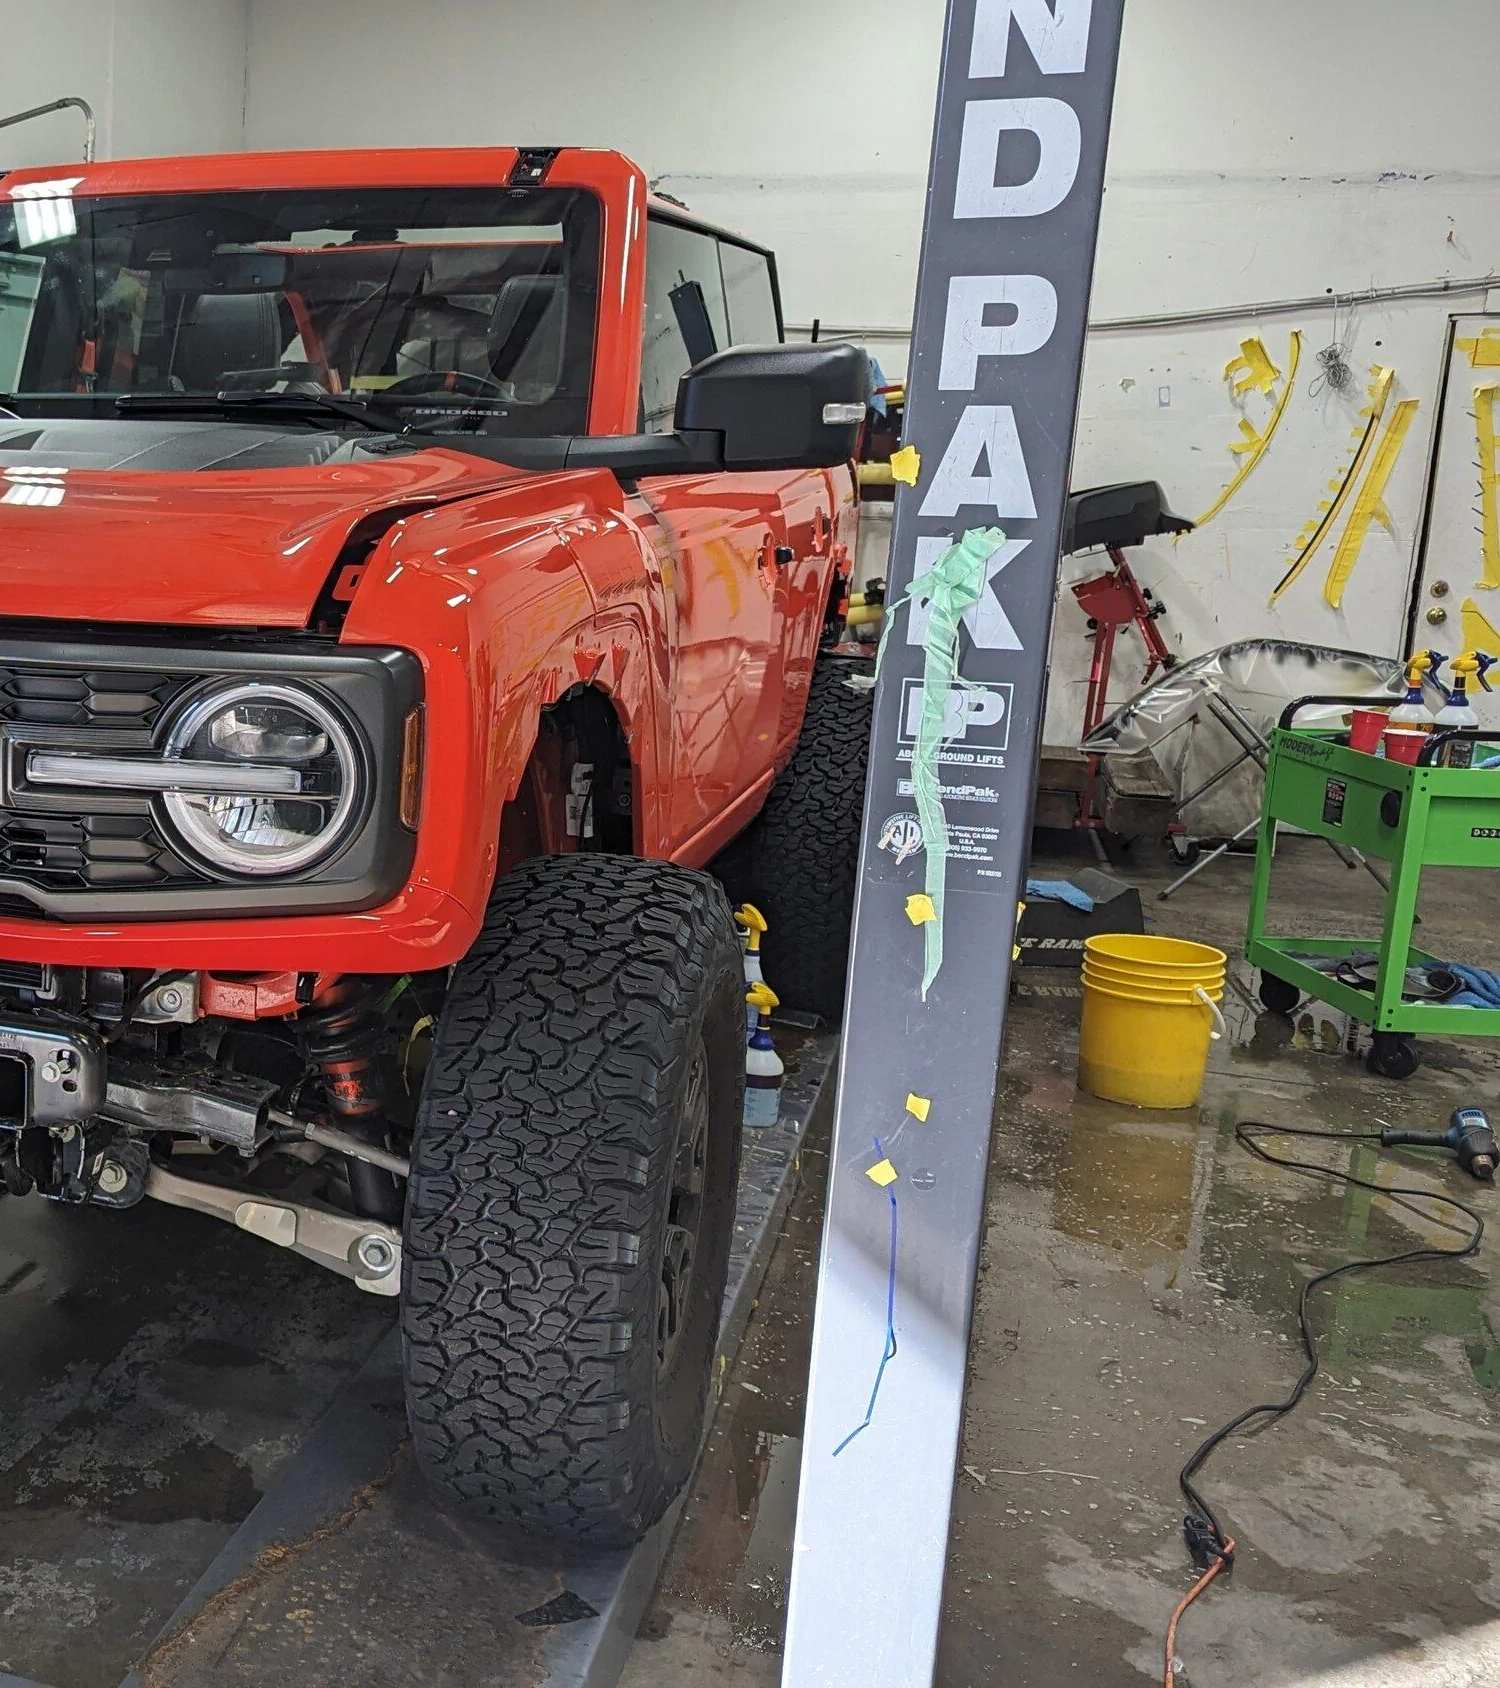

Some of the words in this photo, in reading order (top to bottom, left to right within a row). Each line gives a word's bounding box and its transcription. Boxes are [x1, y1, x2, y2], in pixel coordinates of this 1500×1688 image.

[906, 274, 1057, 650] PAK
[977, 755, 1004, 765] LIFTS
[937, 785, 996, 798] endPak
